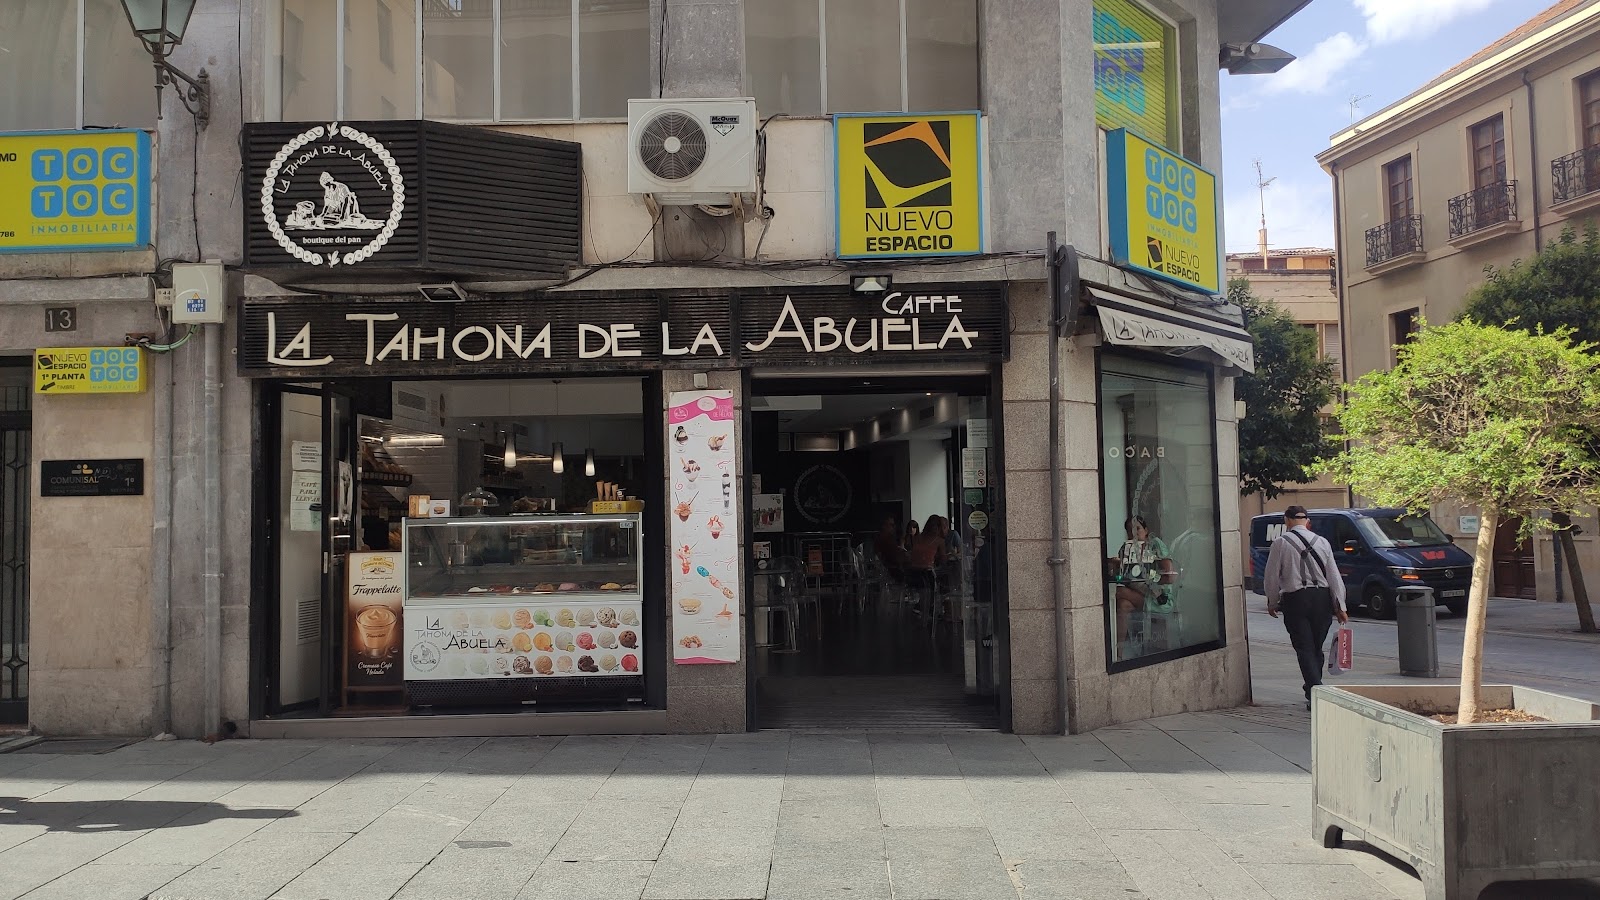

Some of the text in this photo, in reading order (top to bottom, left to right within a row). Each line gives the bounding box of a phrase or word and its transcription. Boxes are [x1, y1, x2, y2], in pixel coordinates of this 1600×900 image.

[37, 150, 129, 178] TOC
[275, 145, 388, 193] LA TAHONA DE LA ABUELA
[1148, 151, 1194, 195] TOC
[37, 187, 129, 213] TOC
[1149, 187, 1195, 229] TOC
[31, 223, 135, 234] INMOBILIARIA
[865, 210, 953, 232] NUEVO
[302, 236, 334, 245] boutique
[347, 237, 362, 245] pan
[866, 234, 953, 252] ESPACIO
[1165, 244, 1200, 270] NUEVO
[1166, 261, 1200, 283] ESPACIO
[881, 291, 963, 315] CAFFE
[47, 309, 72, 330] 13
[1111, 315, 1136, 341] LA
[267, 294, 979, 367] LA TAHONA DE LA ABUELA
[53, 353, 87, 362] NUEVO
[93, 351, 135, 362] TOC
[93, 368, 135, 379] TOC
[50, 476, 100, 485] COMUNISAL
[426, 615, 445, 631] LA
[414, 629, 484, 640] TAHONA DE LA
[441, 634, 507, 651] ABUELA
